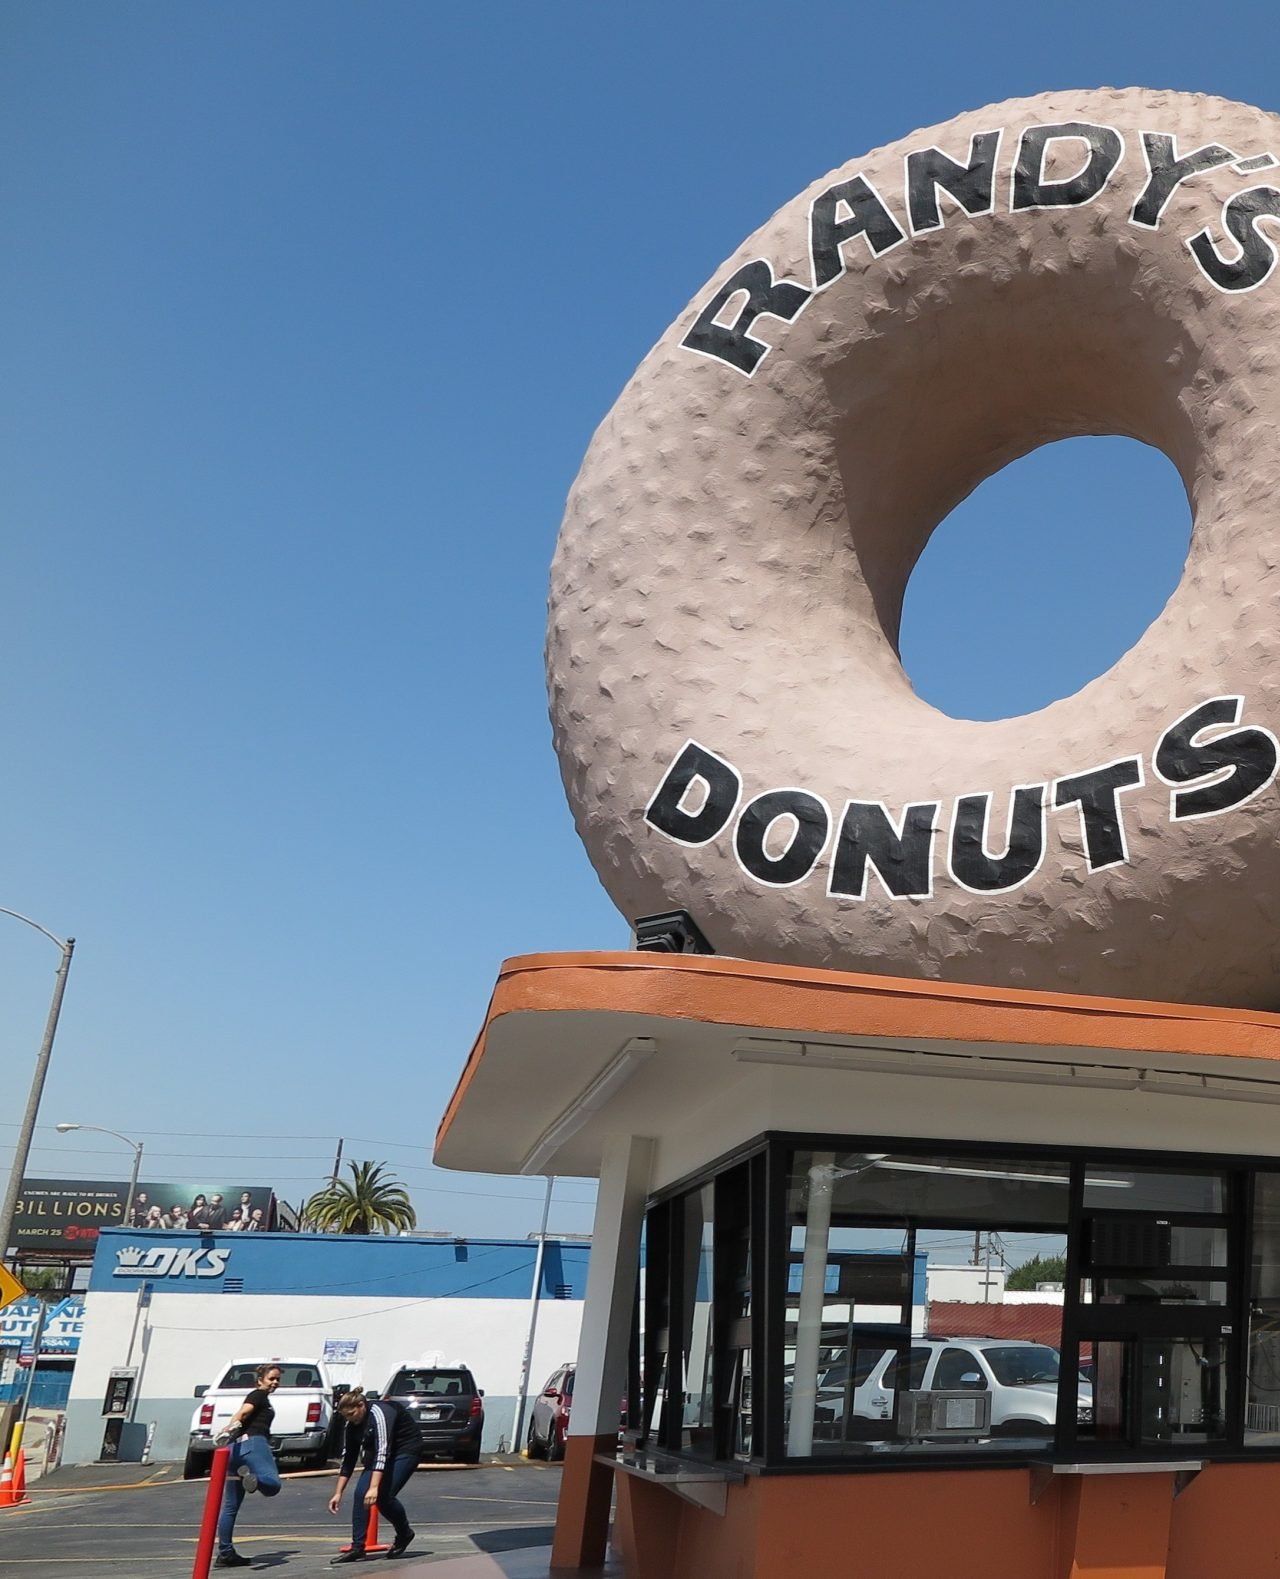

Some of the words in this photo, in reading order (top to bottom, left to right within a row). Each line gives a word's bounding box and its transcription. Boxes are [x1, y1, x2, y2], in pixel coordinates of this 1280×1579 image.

[17, 1228, 49, 1236] MARCH
[50, 1228, 62, 1236] 25
[113, 1247, 231, 1278] DKS
[59, 1321, 84, 1333] TE
